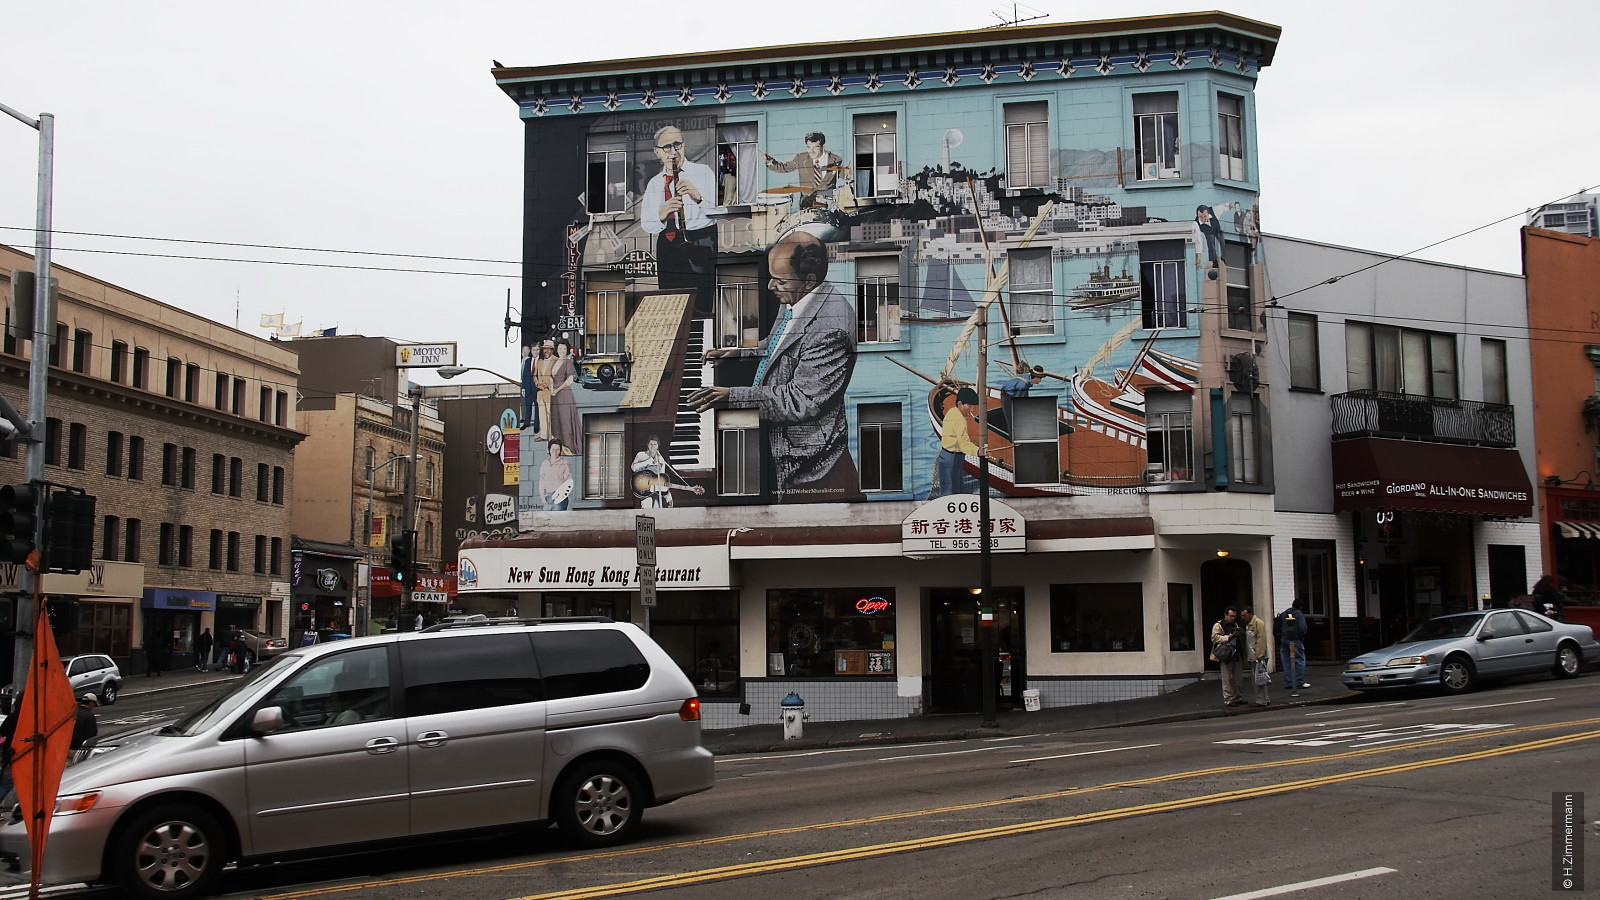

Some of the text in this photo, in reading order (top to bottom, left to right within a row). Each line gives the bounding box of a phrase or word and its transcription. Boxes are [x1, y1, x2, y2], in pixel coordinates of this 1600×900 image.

[684, 115, 715, 130] HOTEL
[413, 347, 448, 356] MOTOR
[421, 356, 440, 364] INN
[1347, 479, 1380, 489] SANDWICHES
[1107, 486, 1148, 496] PRECIOUS
[1478, 488, 1527, 501] SANDWICHES
[486, 497, 512, 512] Royal
[947, 502, 979, 514] 606
[486, 509, 514, 522] Pacific
[637, 521, 653, 532] RIGHT
[637, 535, 654, 545] TURN
[930, 540, 947, 549] TEL.
[638, 549, 654, 560] ONLY
[508, 566, 701, 587] New Sun Hong Kong Rtaurant
[643, 568, 652, 577] NO
[414, 592, 445, 601] GRANT
[856, 598, 888, 612] Open
